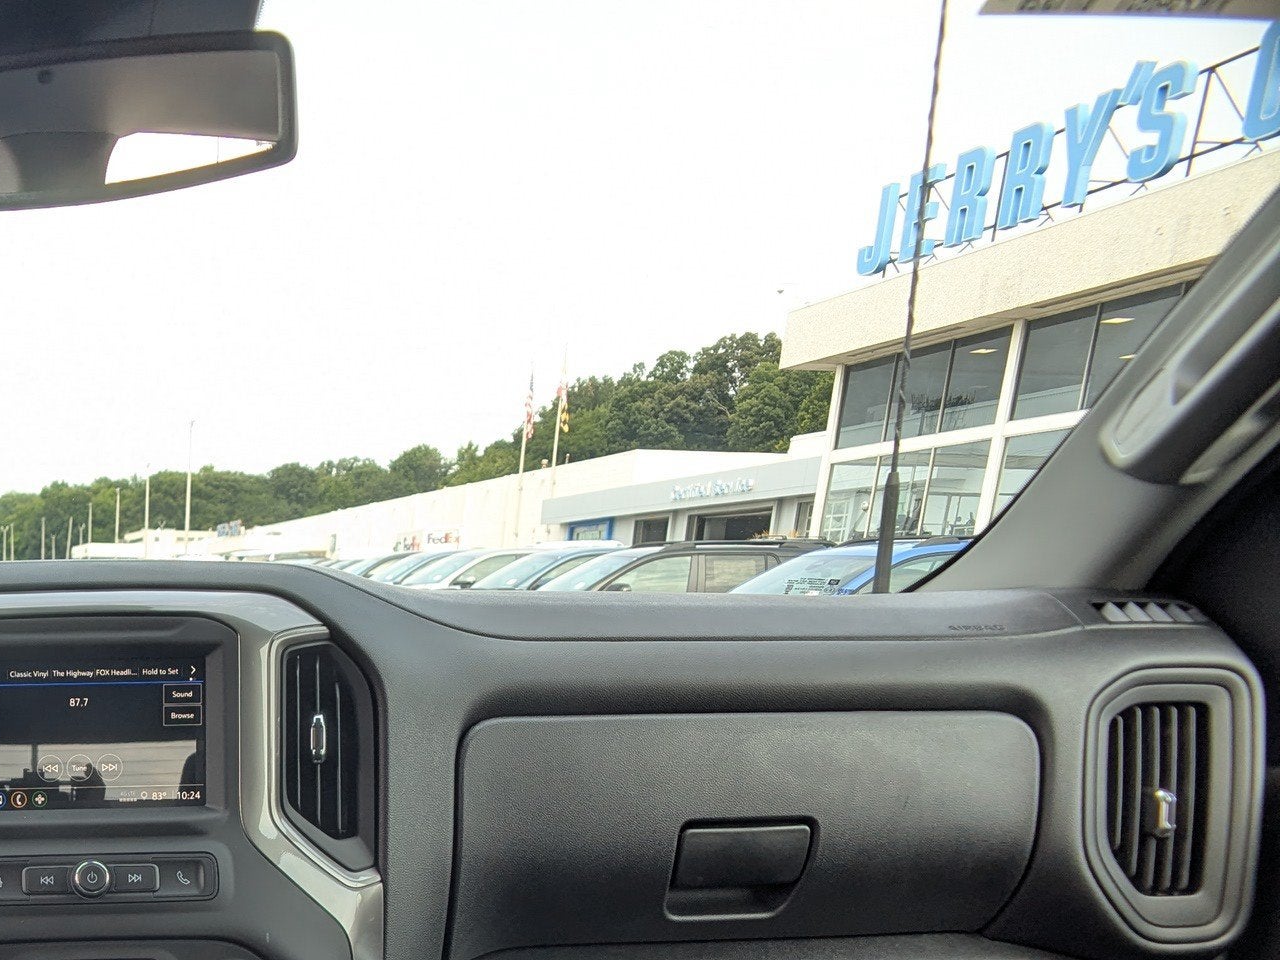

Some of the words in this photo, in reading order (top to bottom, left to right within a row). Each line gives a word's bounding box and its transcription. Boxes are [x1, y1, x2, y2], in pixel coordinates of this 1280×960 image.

[857, 60, 1199, 277] JERRY'S
[9, 670, 32, 678] Classic
[33, 670, 49, 679] Vinyl
[52, 669, 65, 677] The
[66, 669, 94, 678] Highway
[95, 668, 110, 676] FOX
[142, 668, 158, 676] Hold
[167, 667, 179, 675] Set
[172, 690, 193, 698] Sound
[69, 697, 89, 707] 87.7
[170, 711, 195, 720] Browse
[71, 764, 88, 772] Tune
[176, 790, 201, 800] 10:24
